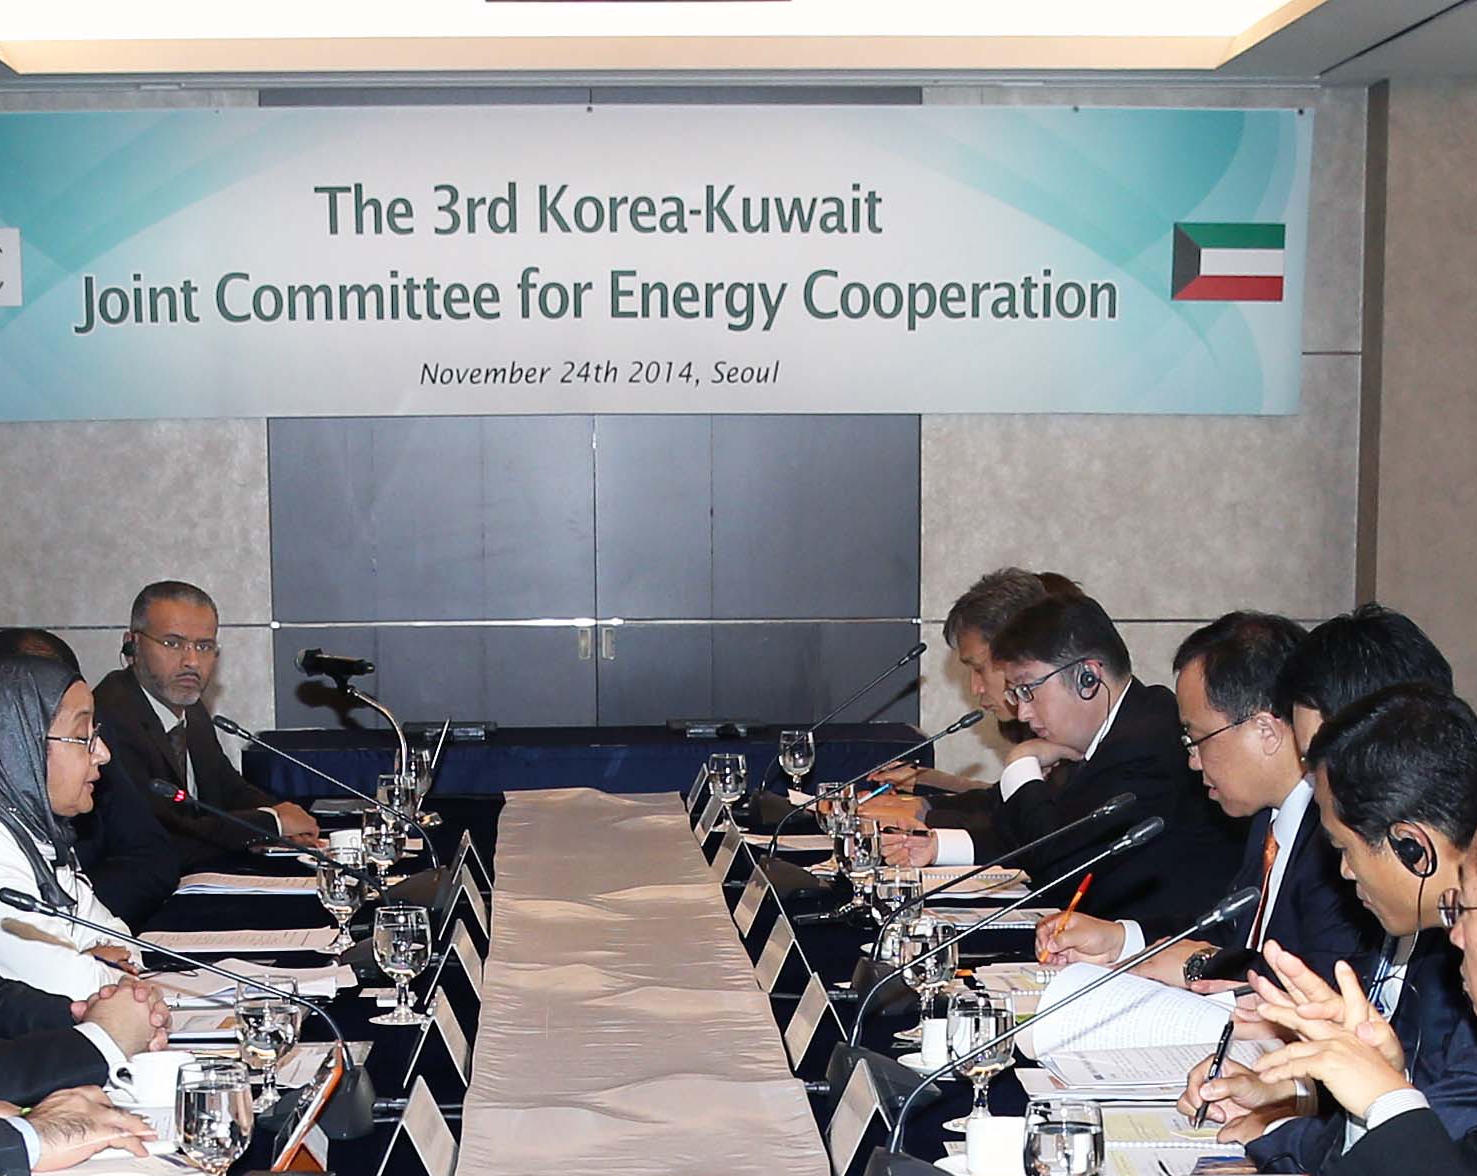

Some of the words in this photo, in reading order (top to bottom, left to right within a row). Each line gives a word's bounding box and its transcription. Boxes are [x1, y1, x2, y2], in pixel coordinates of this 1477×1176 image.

[313, 181, 414, 235] The
[433, 181, 518, 235] 3rd
[538, 182, 884, 235] Korea-Kuwait
[73, 272, 201, 334] Joint
[215, 270, 502, 323] Committee
[516, 265, 594, 319] for
[610, 269, 789, 333] Energy
[803, 267, 1118, 332] Cooperation
[420, 360, 552, 385] November
[559, 360, 619, 384] 24th
[627, 360, 701, 387] 2014,
[710, 359, 781, 384] Seoul
